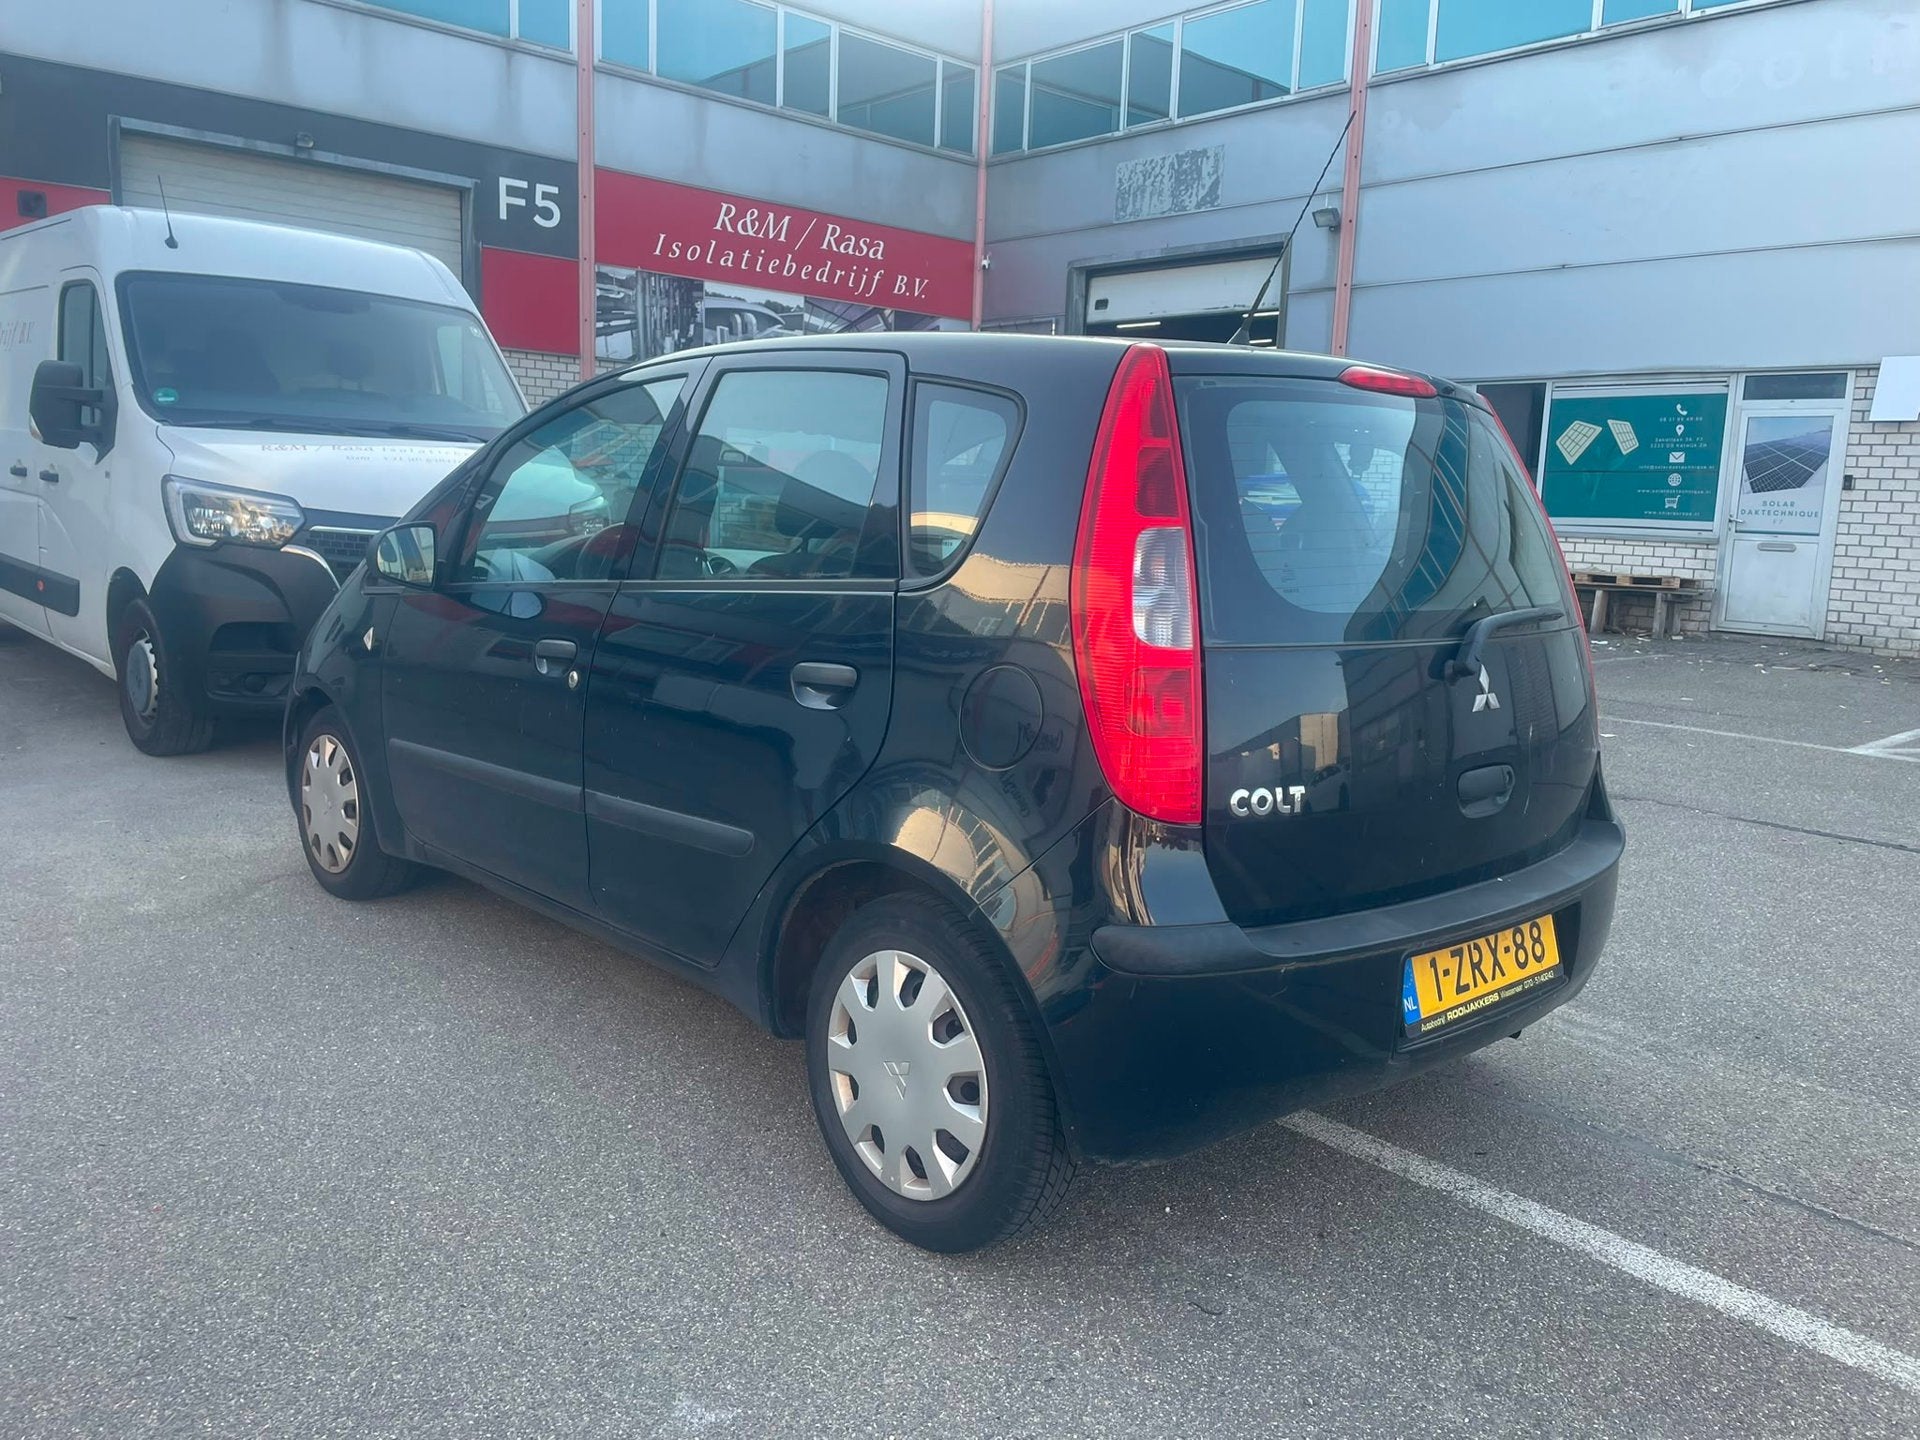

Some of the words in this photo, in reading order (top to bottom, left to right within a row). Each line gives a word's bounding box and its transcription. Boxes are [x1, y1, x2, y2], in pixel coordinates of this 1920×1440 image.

[498, 176, 561, 228] F5
[713, 202, 792, 243] R&M
[820, 223, 885, 260] Rasa
[653, 233, 888, 297] Isolatiebedrijf
[893, 274, 929, 299] B.V.
[1740, 509, 1819, 518] DAKTECHNIQUE
[1762, 500, 1796, 508] SOLAR
[1229, 785, 1306, 817] COLT
[1429, 920, 1546, 1002] 1-ZRX-88
[1404, 996, 1418, 1012] NL
[1446, 992, 1499, 1021] ROOIJAKKERS
